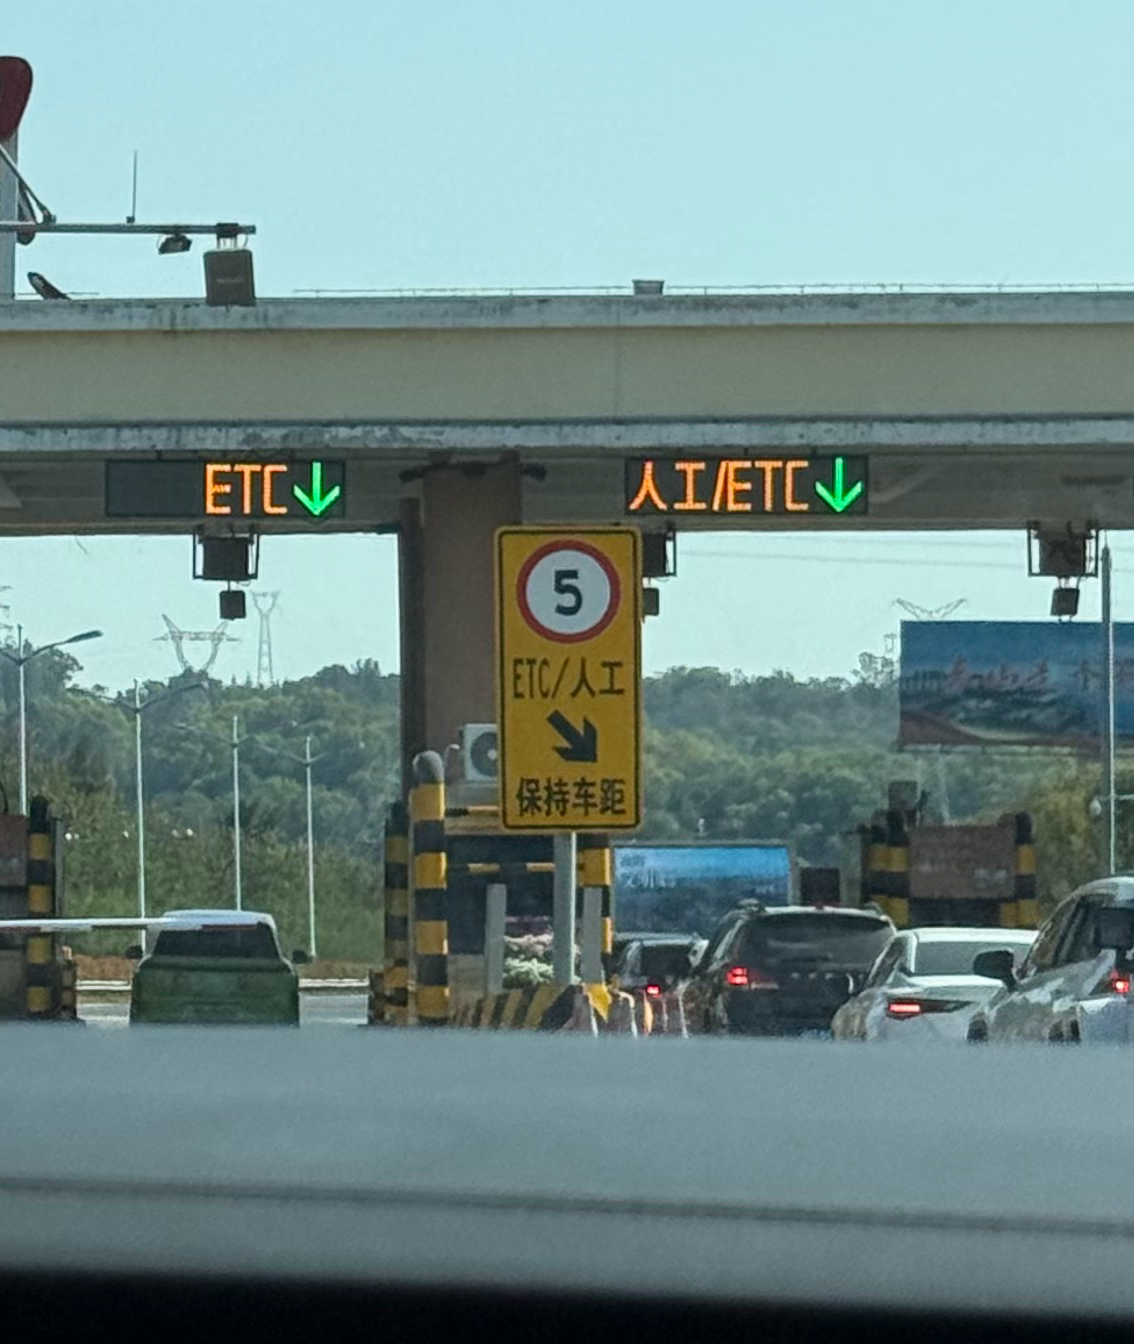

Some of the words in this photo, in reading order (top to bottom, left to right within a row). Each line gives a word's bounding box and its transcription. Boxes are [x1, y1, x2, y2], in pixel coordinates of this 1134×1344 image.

[205, 463, 287, 515] ETC
[629, 460, 809, 511] 人工/ETC
[554, 569, 583, 617] 5
[512, 657, 625, 700] ETC/人工
[515, 776, 627, 818] 保持车距
